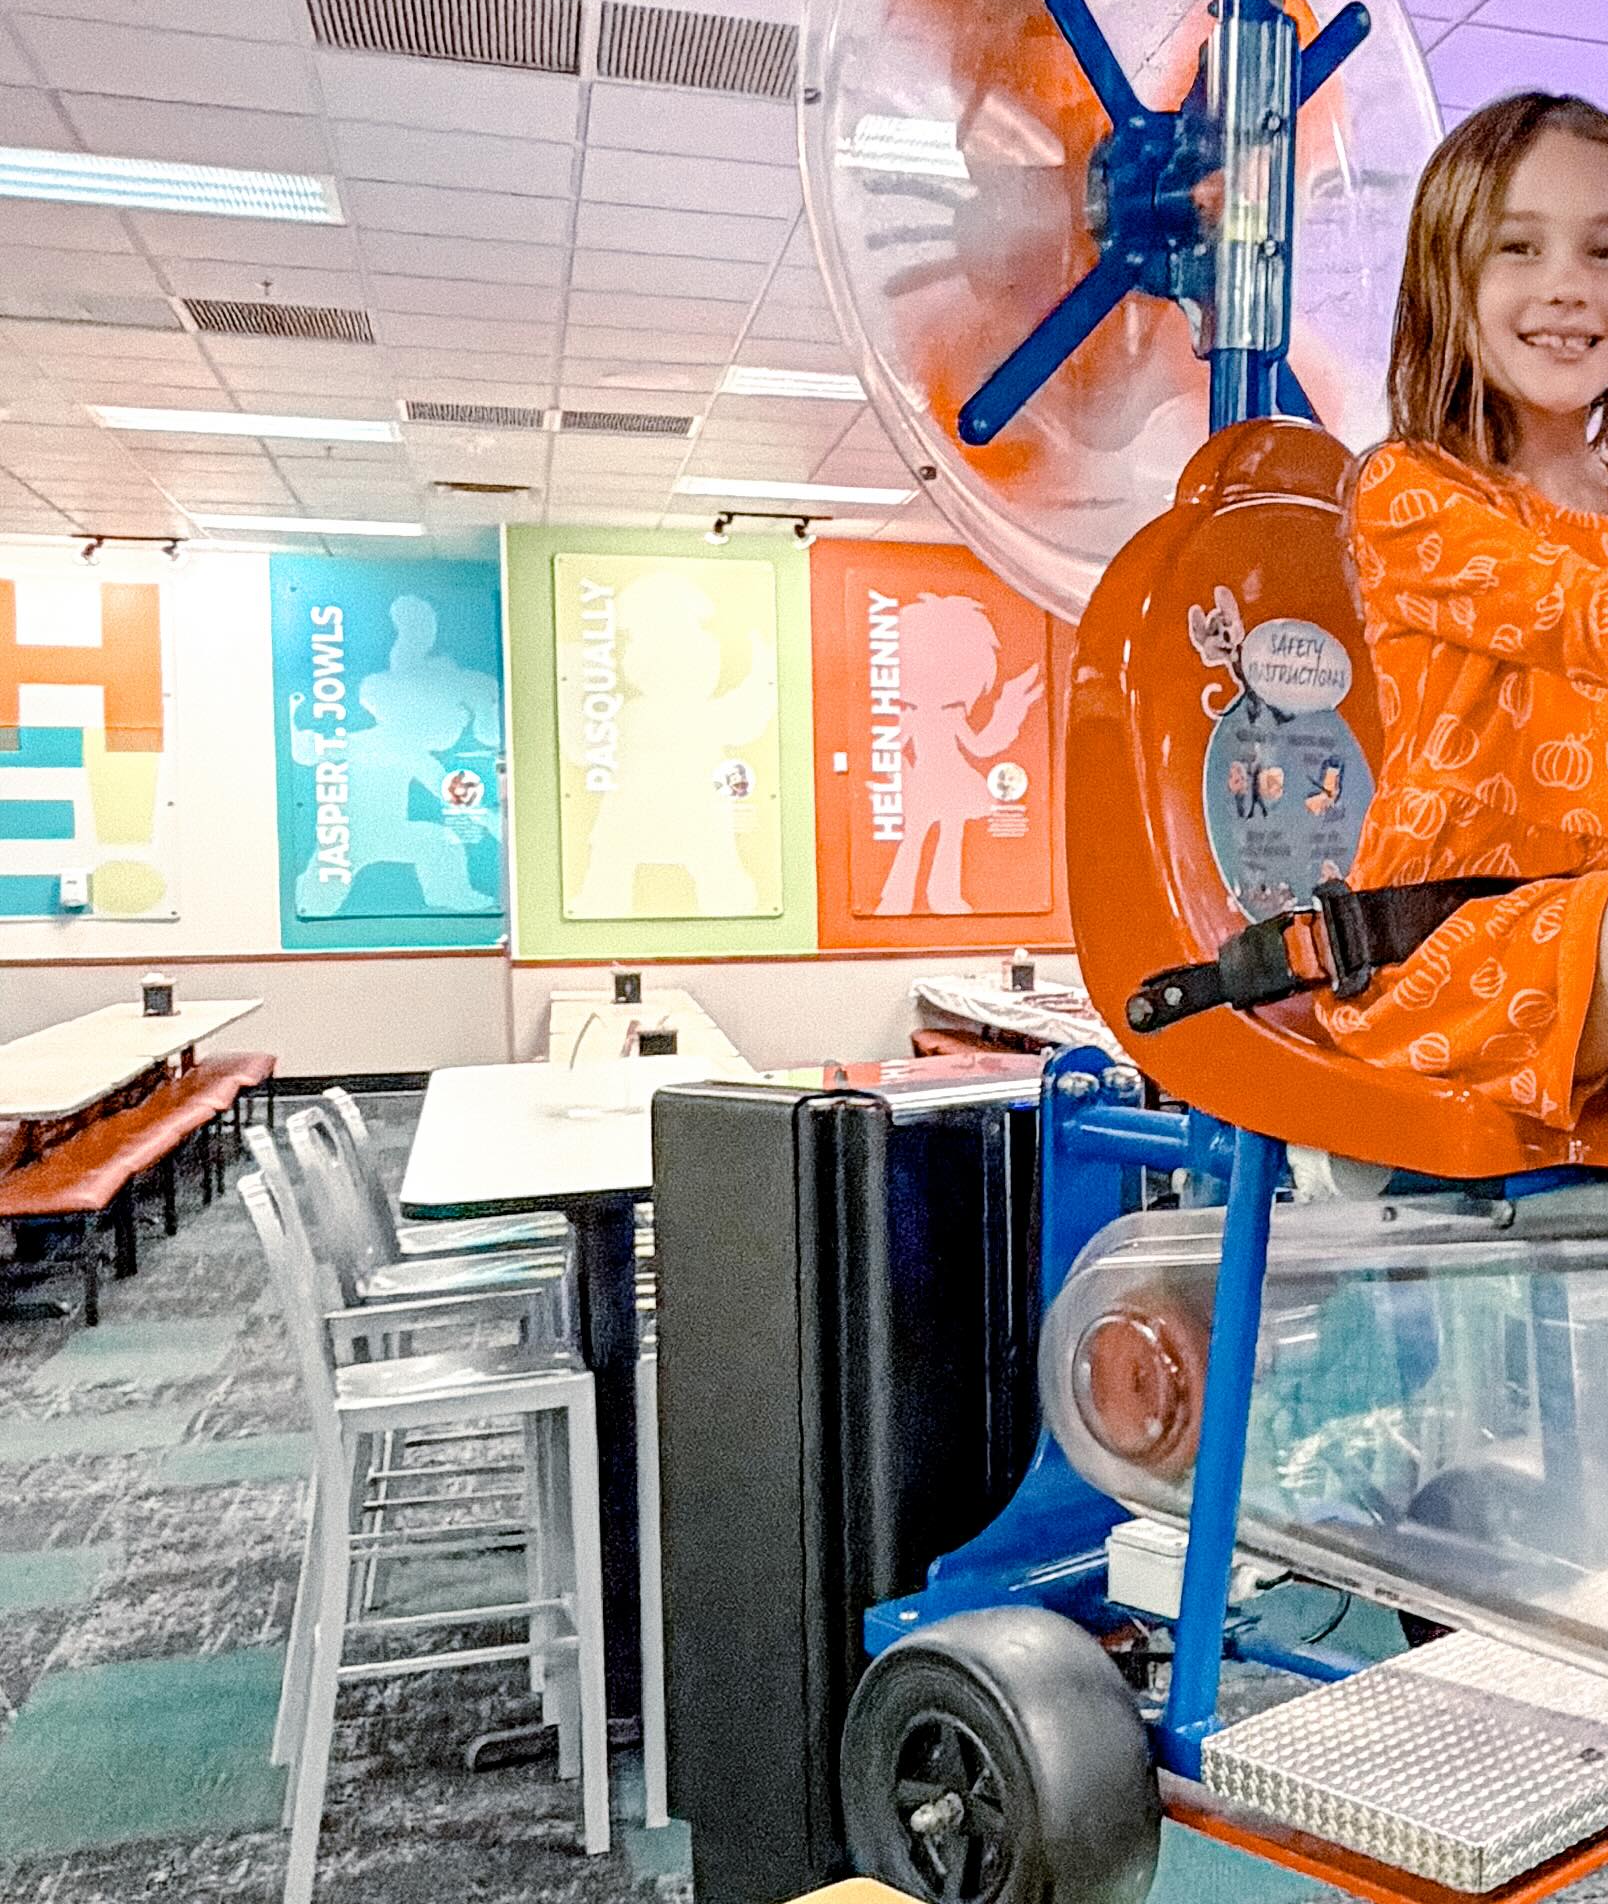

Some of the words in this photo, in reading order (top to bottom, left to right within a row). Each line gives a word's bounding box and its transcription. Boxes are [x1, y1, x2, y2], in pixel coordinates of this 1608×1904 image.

[310, 604, 347, 721] JOWLS
[580, 576, 622, 793] PASQUALLY
[868, 588, 901, 715] HENNY
[1271, 632, 1326, 664] SAFETY
[315, 726, 347, 755] T.
[871, 724, 904, 841] HELEN
[316, 760, 352, 886] JASPER
